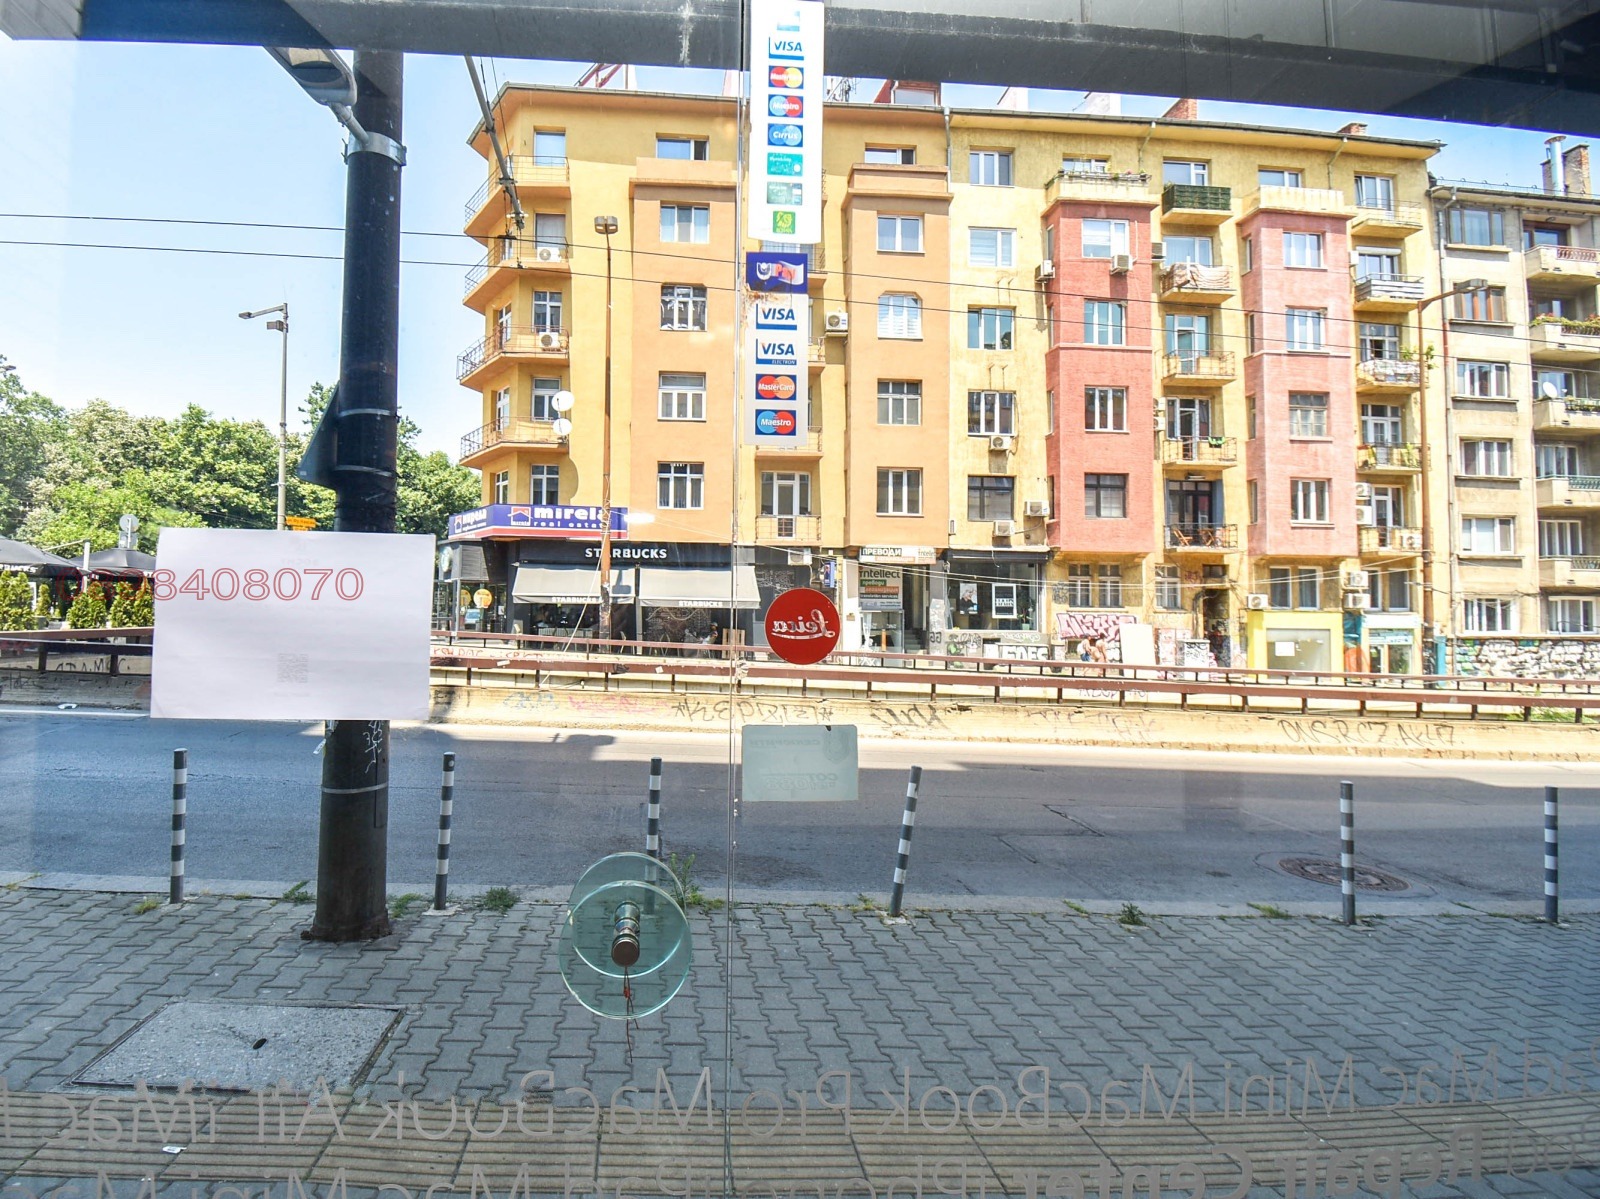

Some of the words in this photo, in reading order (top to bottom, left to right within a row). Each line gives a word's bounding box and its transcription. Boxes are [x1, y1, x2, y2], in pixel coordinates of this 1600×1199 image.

[774, 41, 803, 52] VISA
[772, 102, 799, 111] Maestro
[773, 131, 798, 140] Cirrus
[762, 308, 795, 321] VISA
[761, 343, 795, 356] VISA
[758, 383, 795, 392] MasterCard
[761, 418, 791, 427] Maestro
[585, 547, 667, 559] STRBUCKS
[862, 547, 901, 558] ПРЕВОДИ
